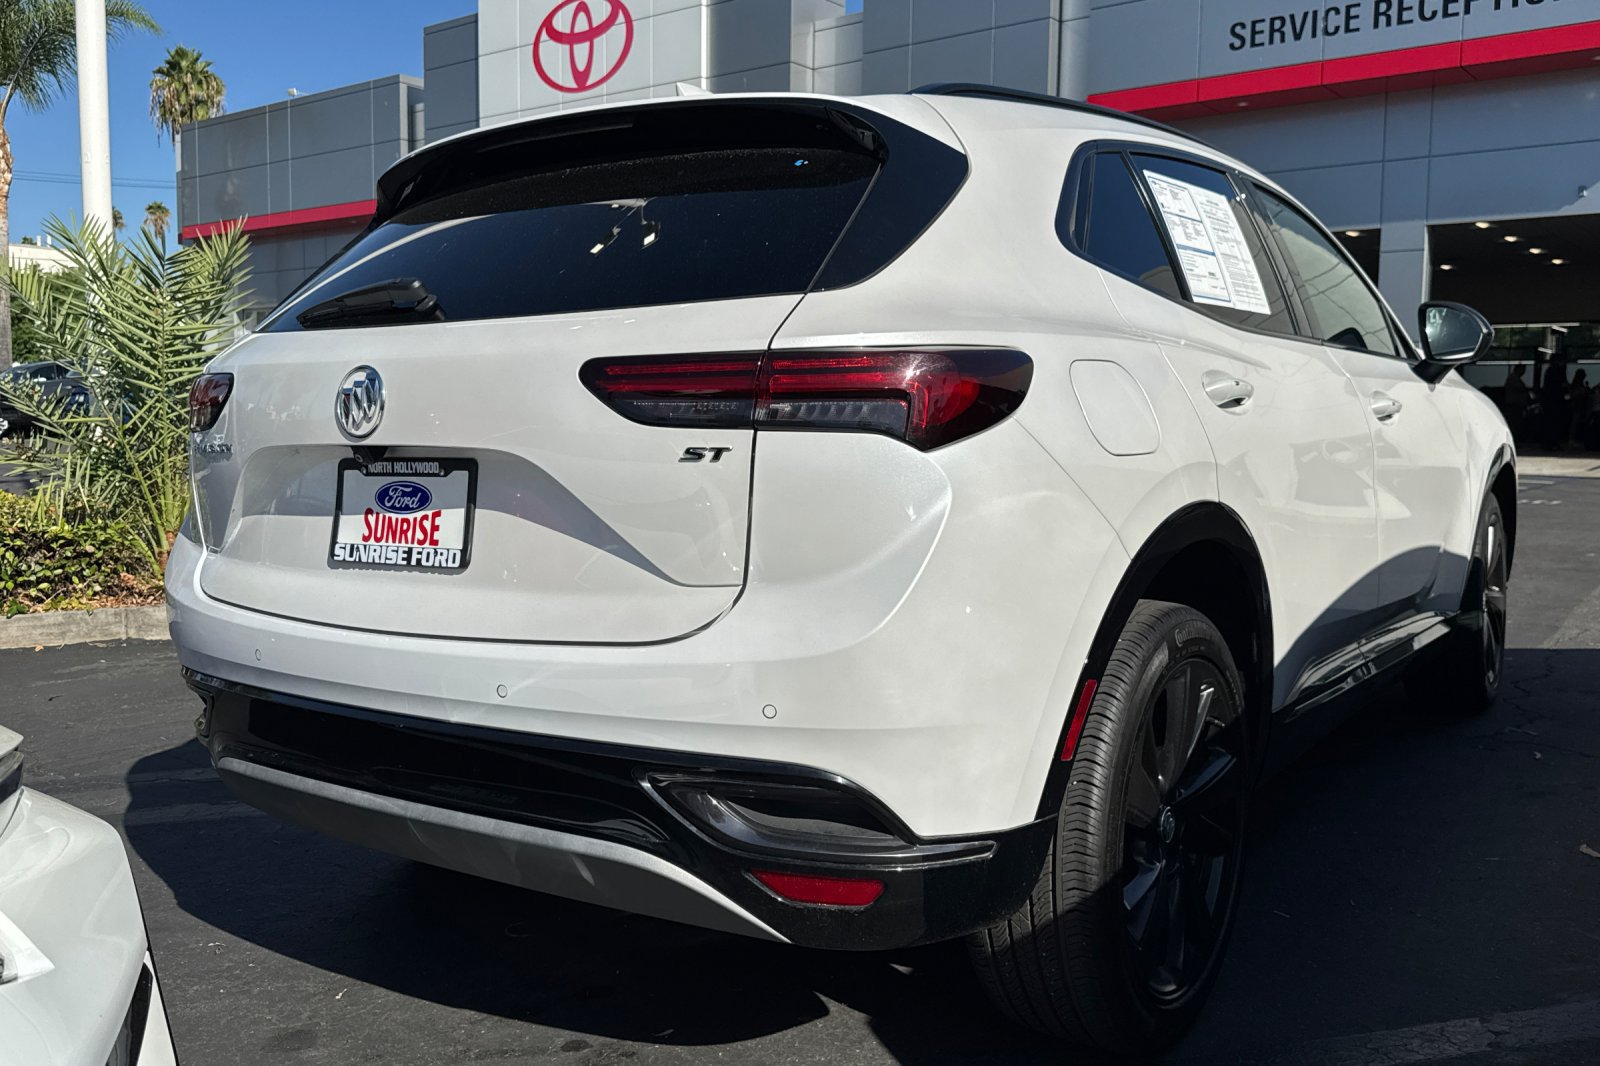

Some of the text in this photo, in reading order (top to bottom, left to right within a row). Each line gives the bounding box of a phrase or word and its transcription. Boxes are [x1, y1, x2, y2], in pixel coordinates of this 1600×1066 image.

[1228, 3, 1361, 51] SERVICE
[678, 446, 733, 463] ST
[368, 461, 439, 473] NORTH HOLLYWOOD
[384, 486, 421, 508] Ford
[362, 507, 442, 546] SUNRISE
[334, 543, 461, 567] SUNRISE FORD
